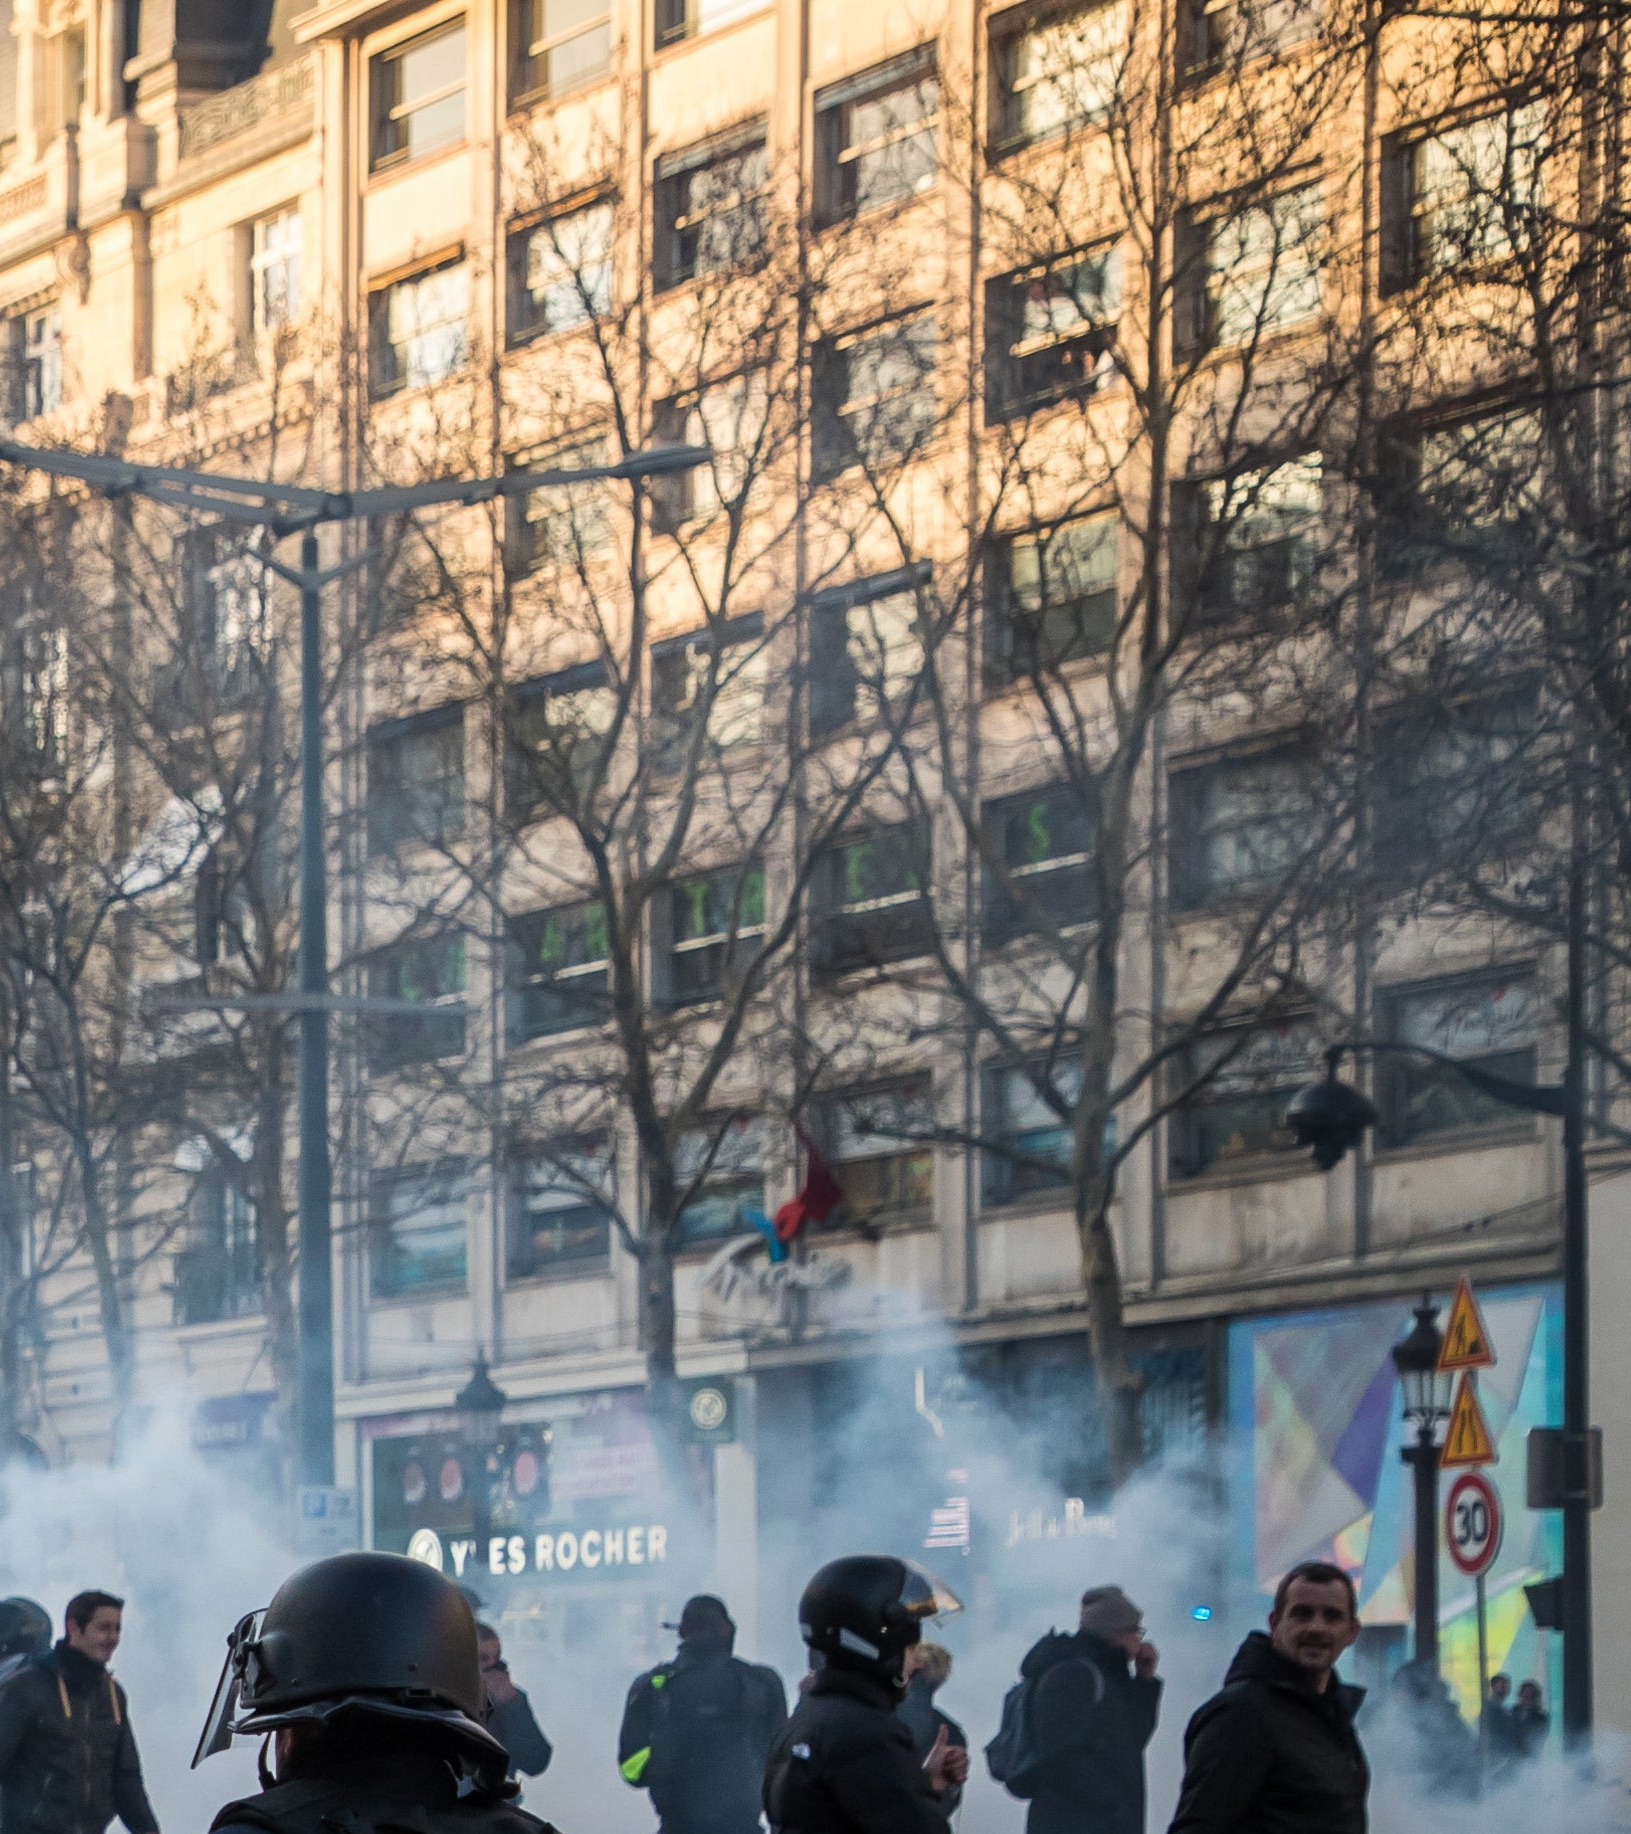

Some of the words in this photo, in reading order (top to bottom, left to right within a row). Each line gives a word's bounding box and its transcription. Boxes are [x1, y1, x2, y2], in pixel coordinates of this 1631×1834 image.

[1456, 1501, 1488, 1546] 30
[449, 1535, 527, 1577] YES
[535, 1524, 669, 1572] ROCHER
